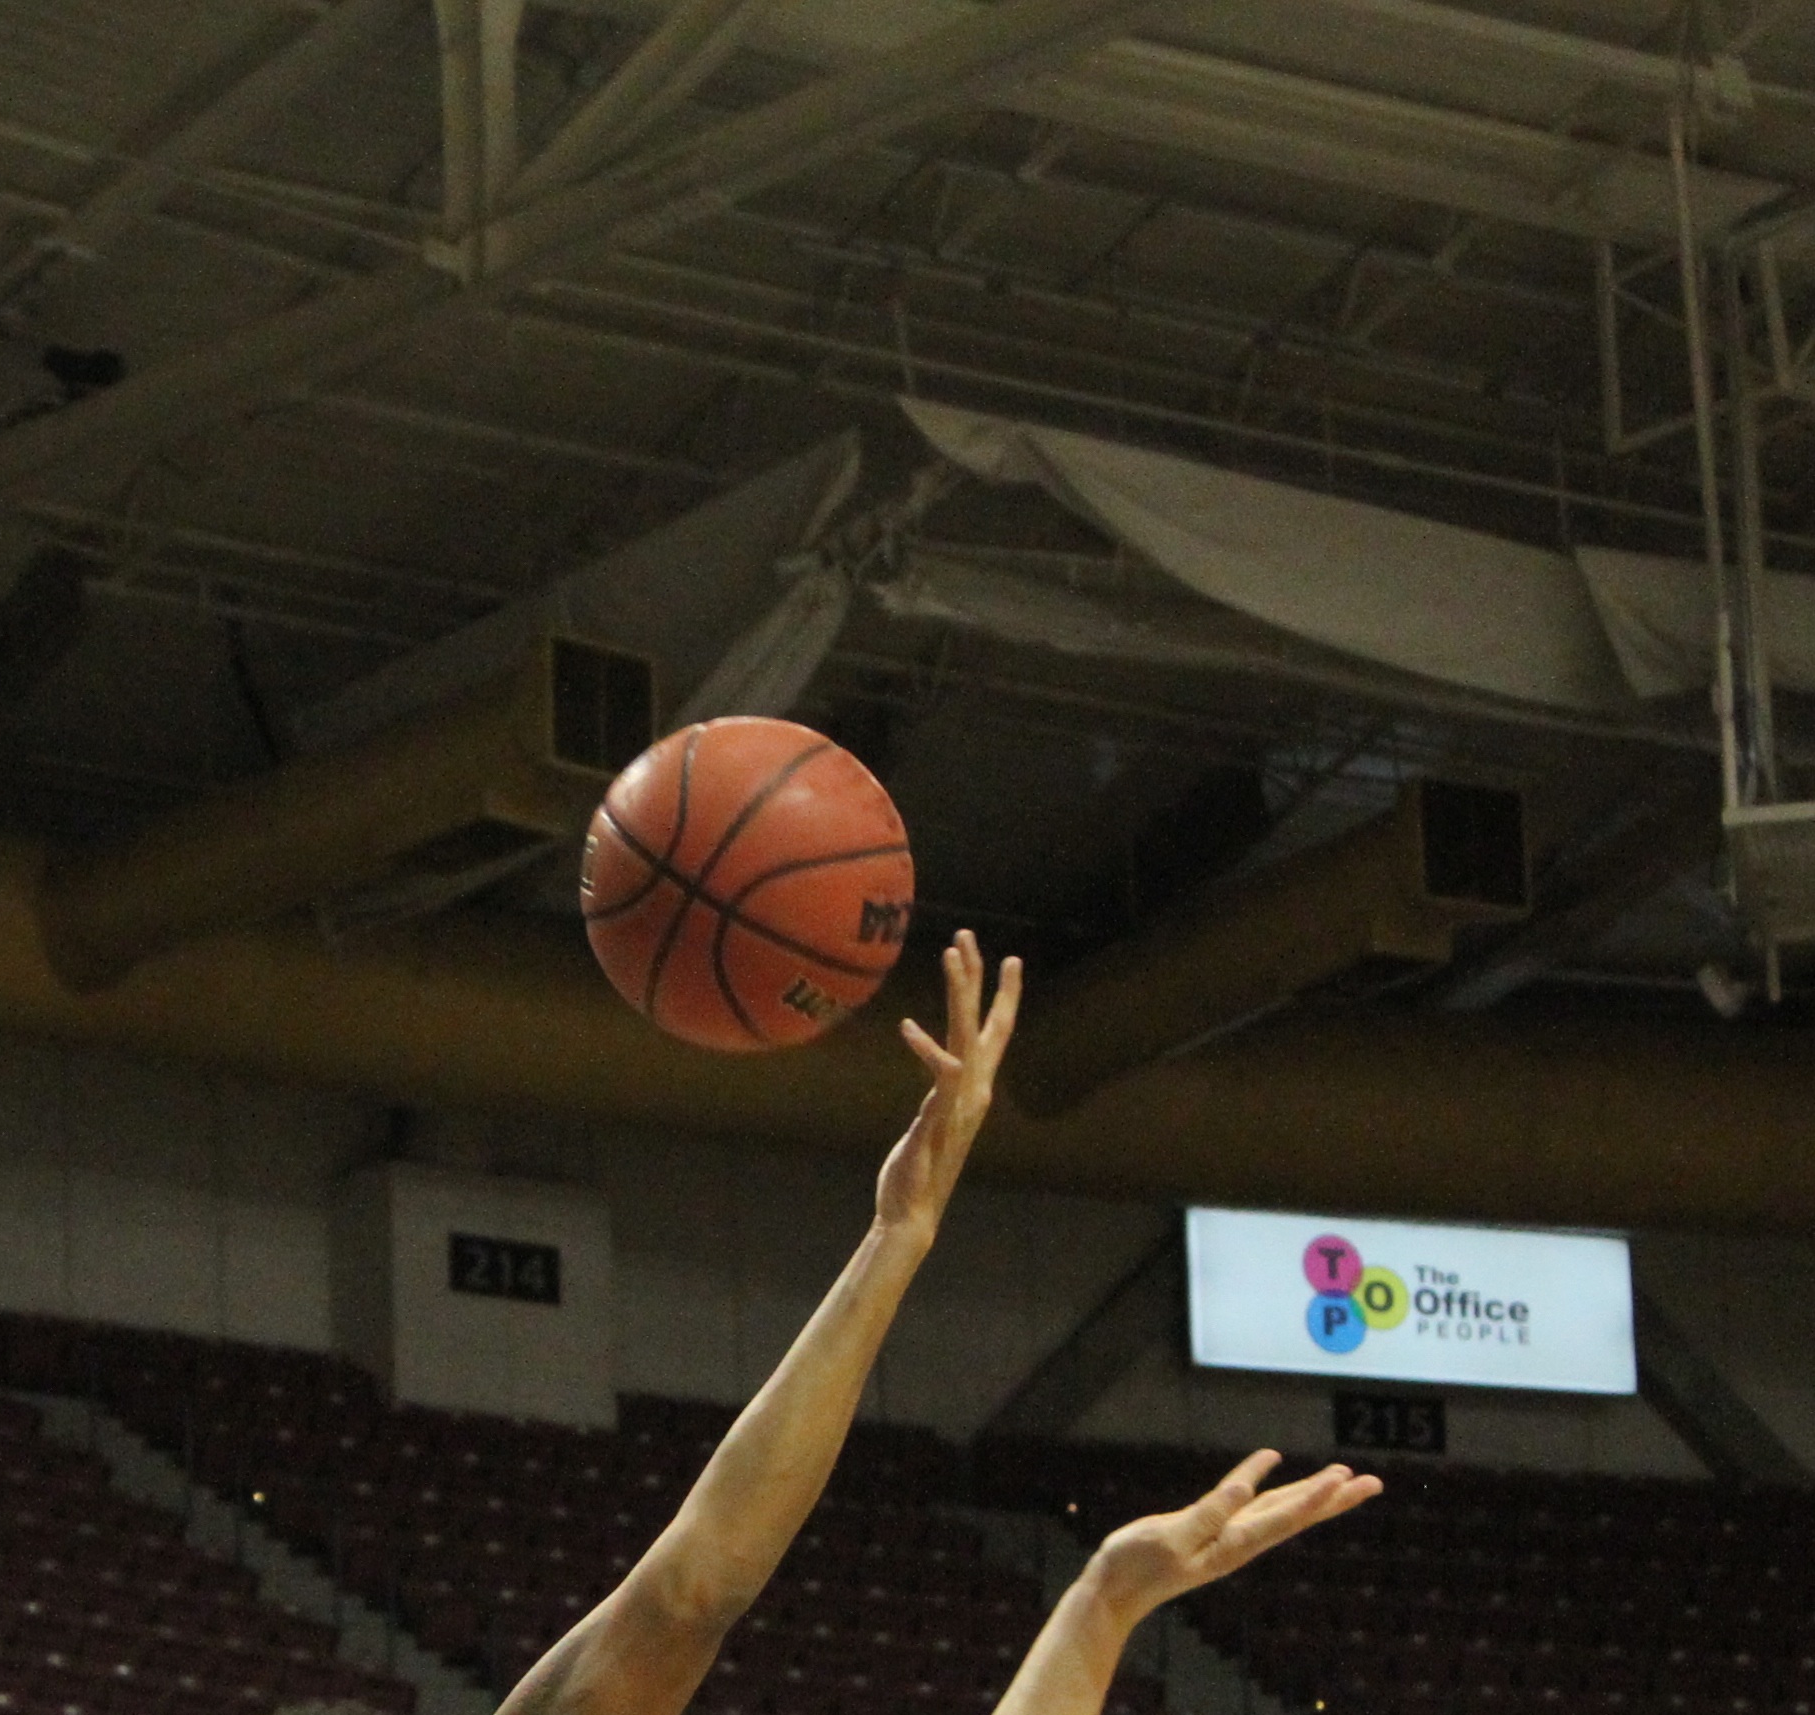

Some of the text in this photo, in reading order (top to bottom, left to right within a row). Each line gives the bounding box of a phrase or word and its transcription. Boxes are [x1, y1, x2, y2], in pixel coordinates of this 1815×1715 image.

[1414, 1265, 1460, 1286] The
[1414, 1287, 1530, 1324] Office
[1417, 1319, 1532, 1345] PEOPLE
